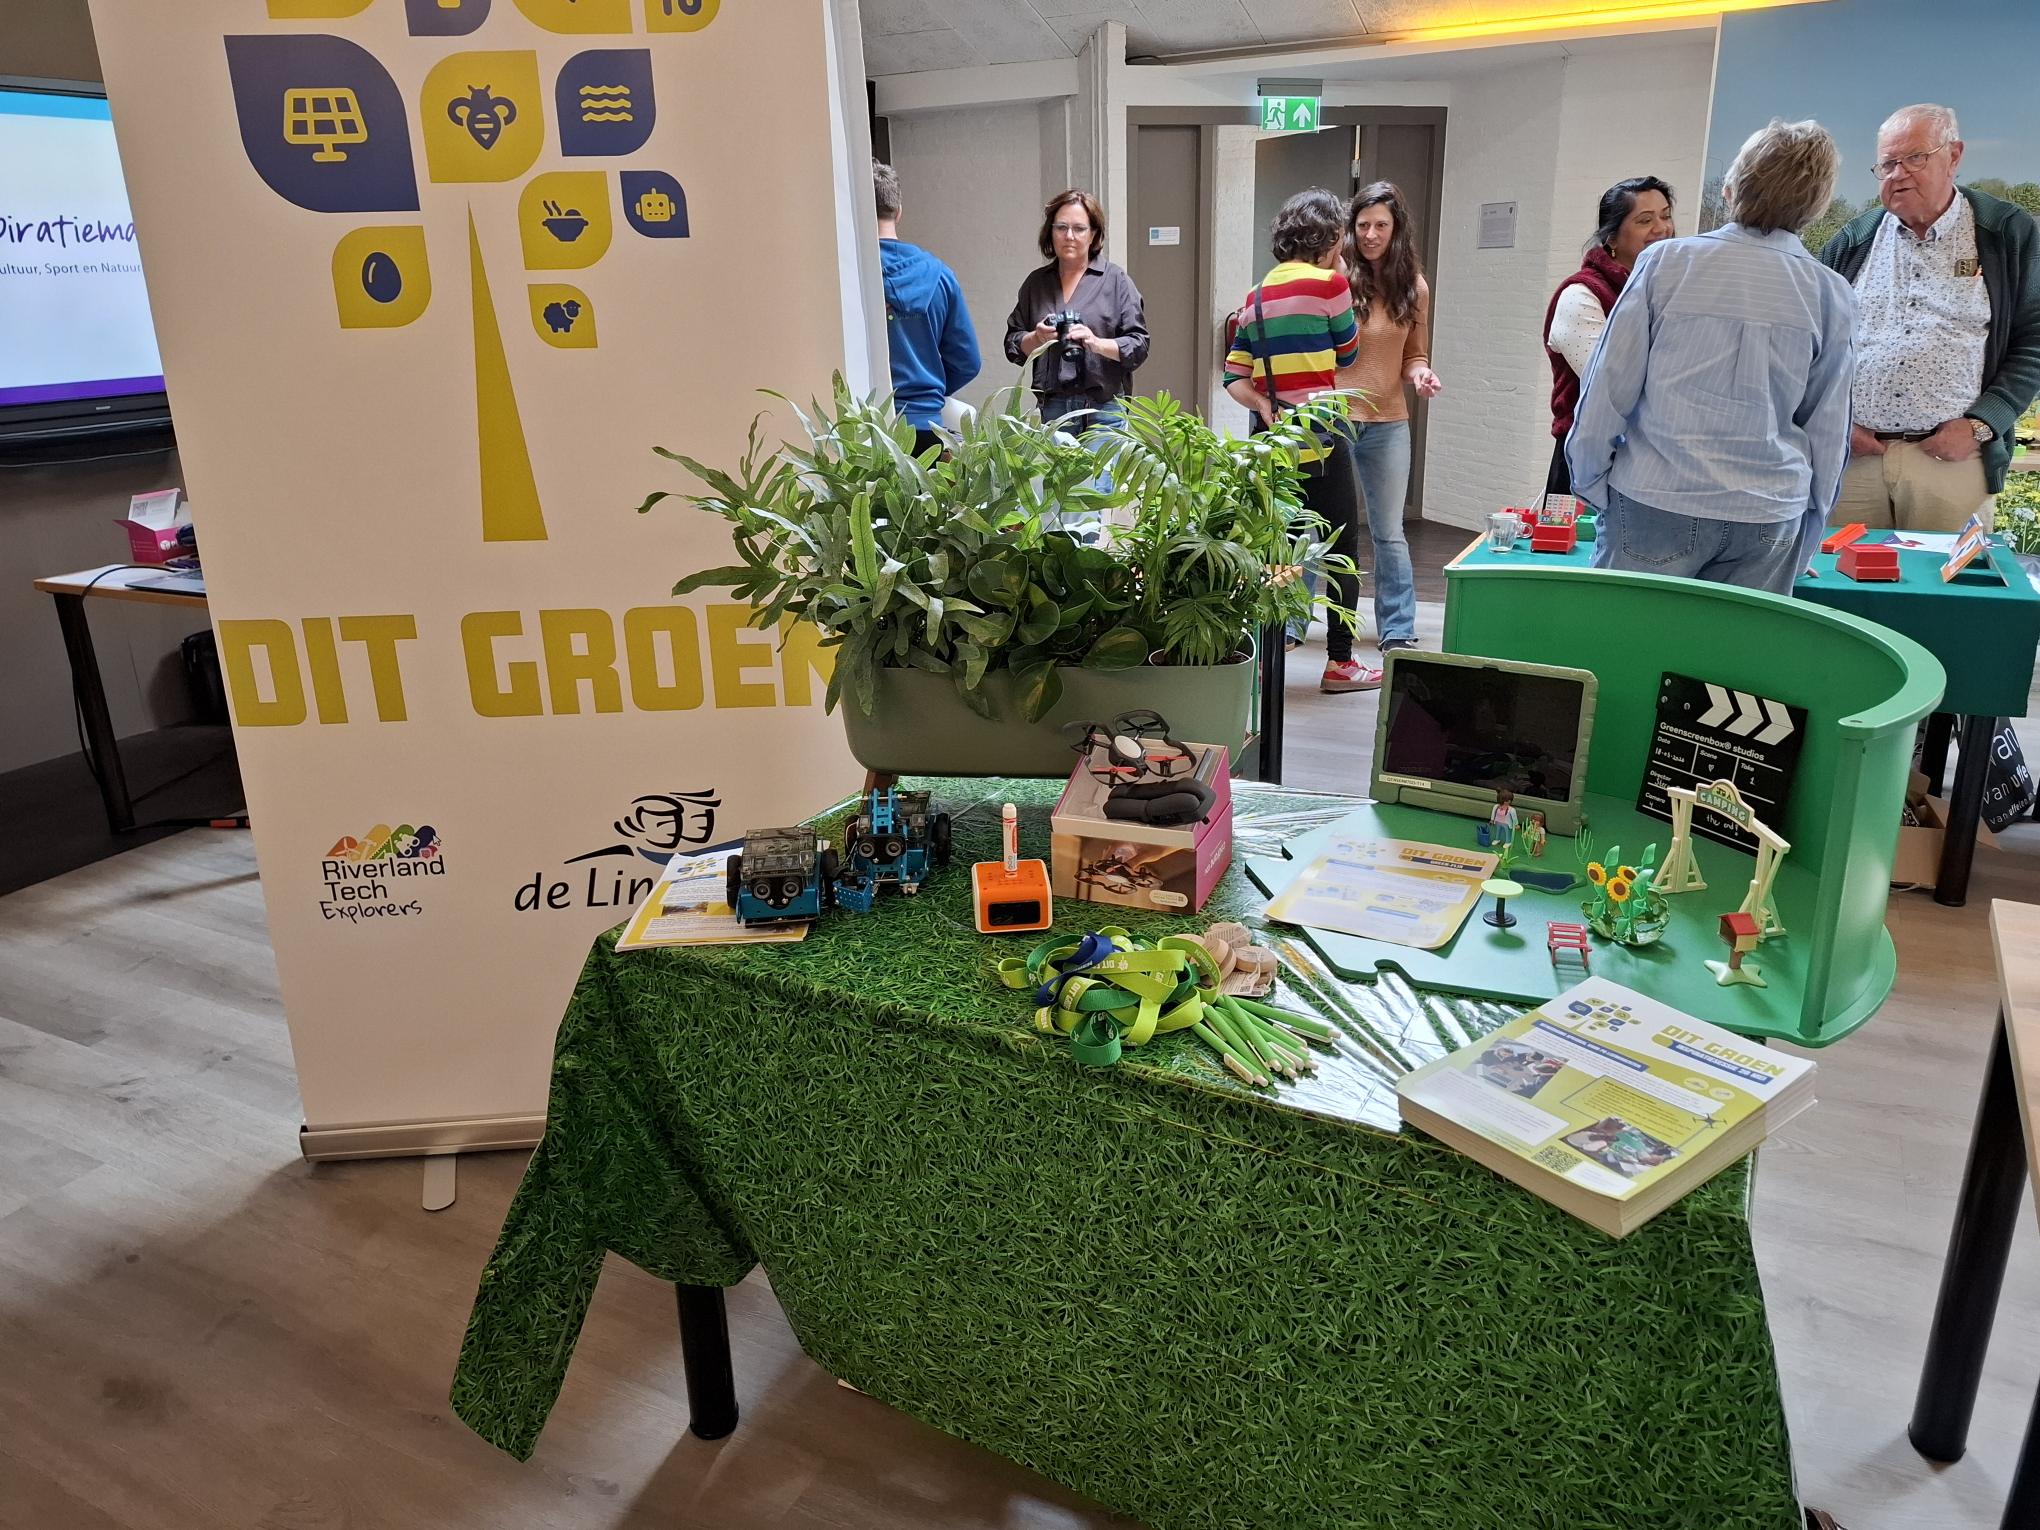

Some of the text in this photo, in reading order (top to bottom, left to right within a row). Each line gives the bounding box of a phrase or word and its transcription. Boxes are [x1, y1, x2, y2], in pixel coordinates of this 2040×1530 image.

[45, 262, 79, 277] Sport
[83, 265, 98, 274] en
[218, 614, 418, 727] DIT
[1657, 736, 1671, 745] Date
[1700, 750, 1718, 760] Scene
[1732, 745, 1765, 761] studios
[1650, 770, 1672, 782] Director
[1740, 763, 1755, 772] Take
[1645, 792, 1666, 804] Camera
[1983, 782, 2010, 805] van
[1700, 792, 1746, 821] CAMPING
[1706, 814, 1721, 826] the
[1990, 813, 2008, 825] van
[1401, 847, 1487, 867] DIT GROEN
[322, 855, 445, 880] Riverland
[324, 879, 388, 901] Tech
[514, 872, 571, 912] de
[319, 900, 422, 924] Explorers
[1660, 1025, 1786, 1076] DIT GROEN
